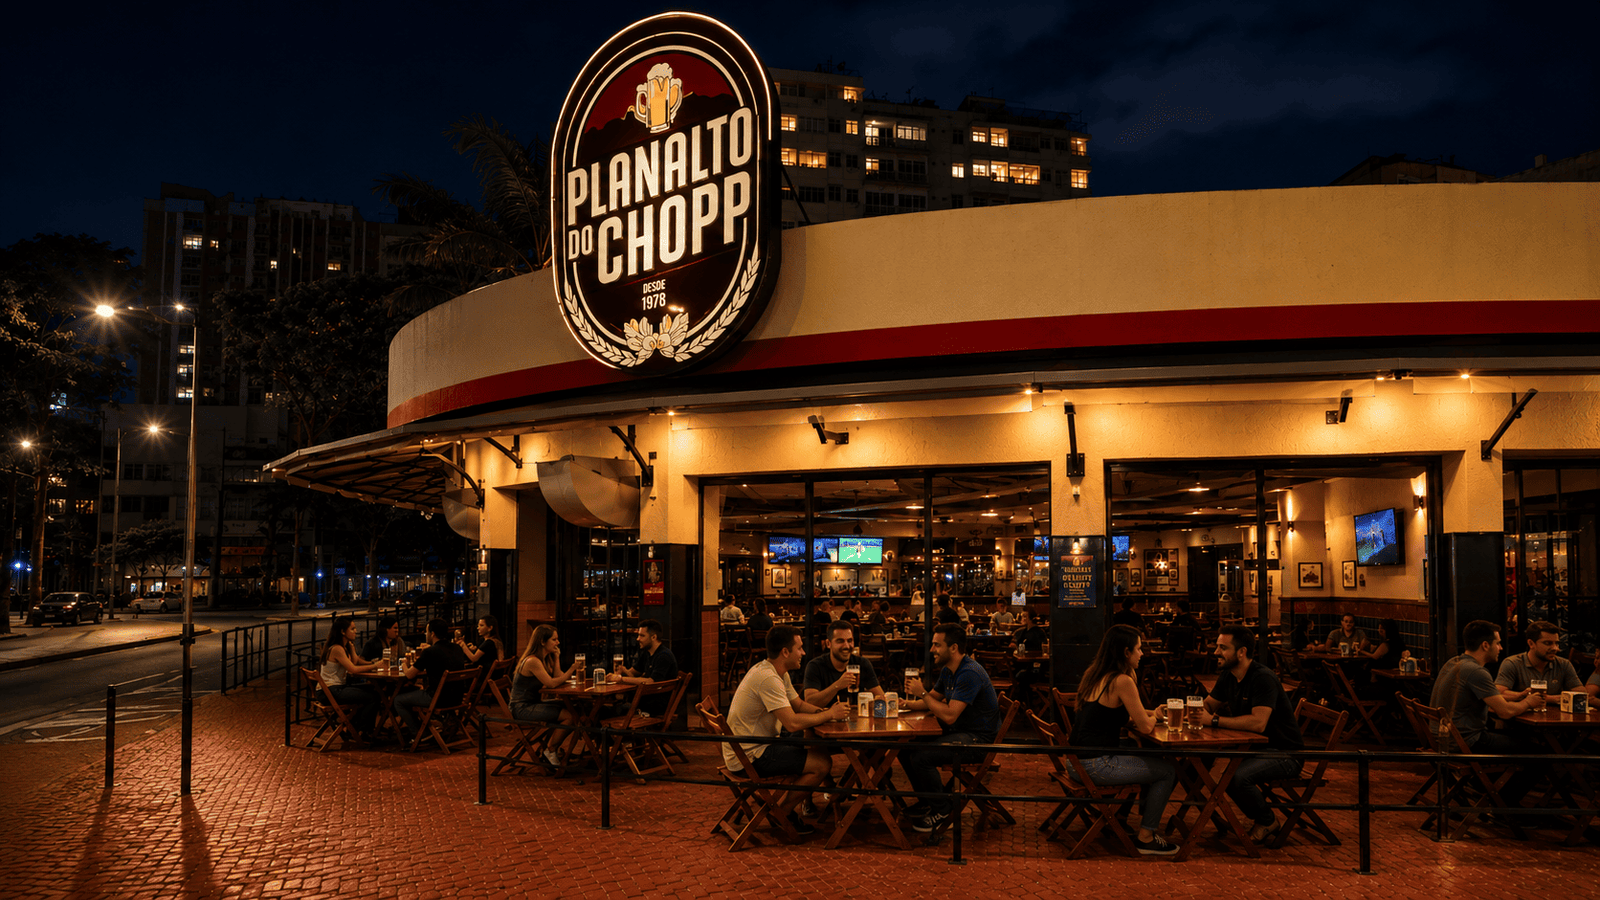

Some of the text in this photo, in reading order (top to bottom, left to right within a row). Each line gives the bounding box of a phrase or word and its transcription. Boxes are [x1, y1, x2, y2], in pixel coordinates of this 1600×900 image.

[567, 107, 752, 226] PLANALTO
[568, 171, 751, 285] DO CHOPP
[641, 292, 666, 311] 1978
[642, 279, 666, 294] DESDE
